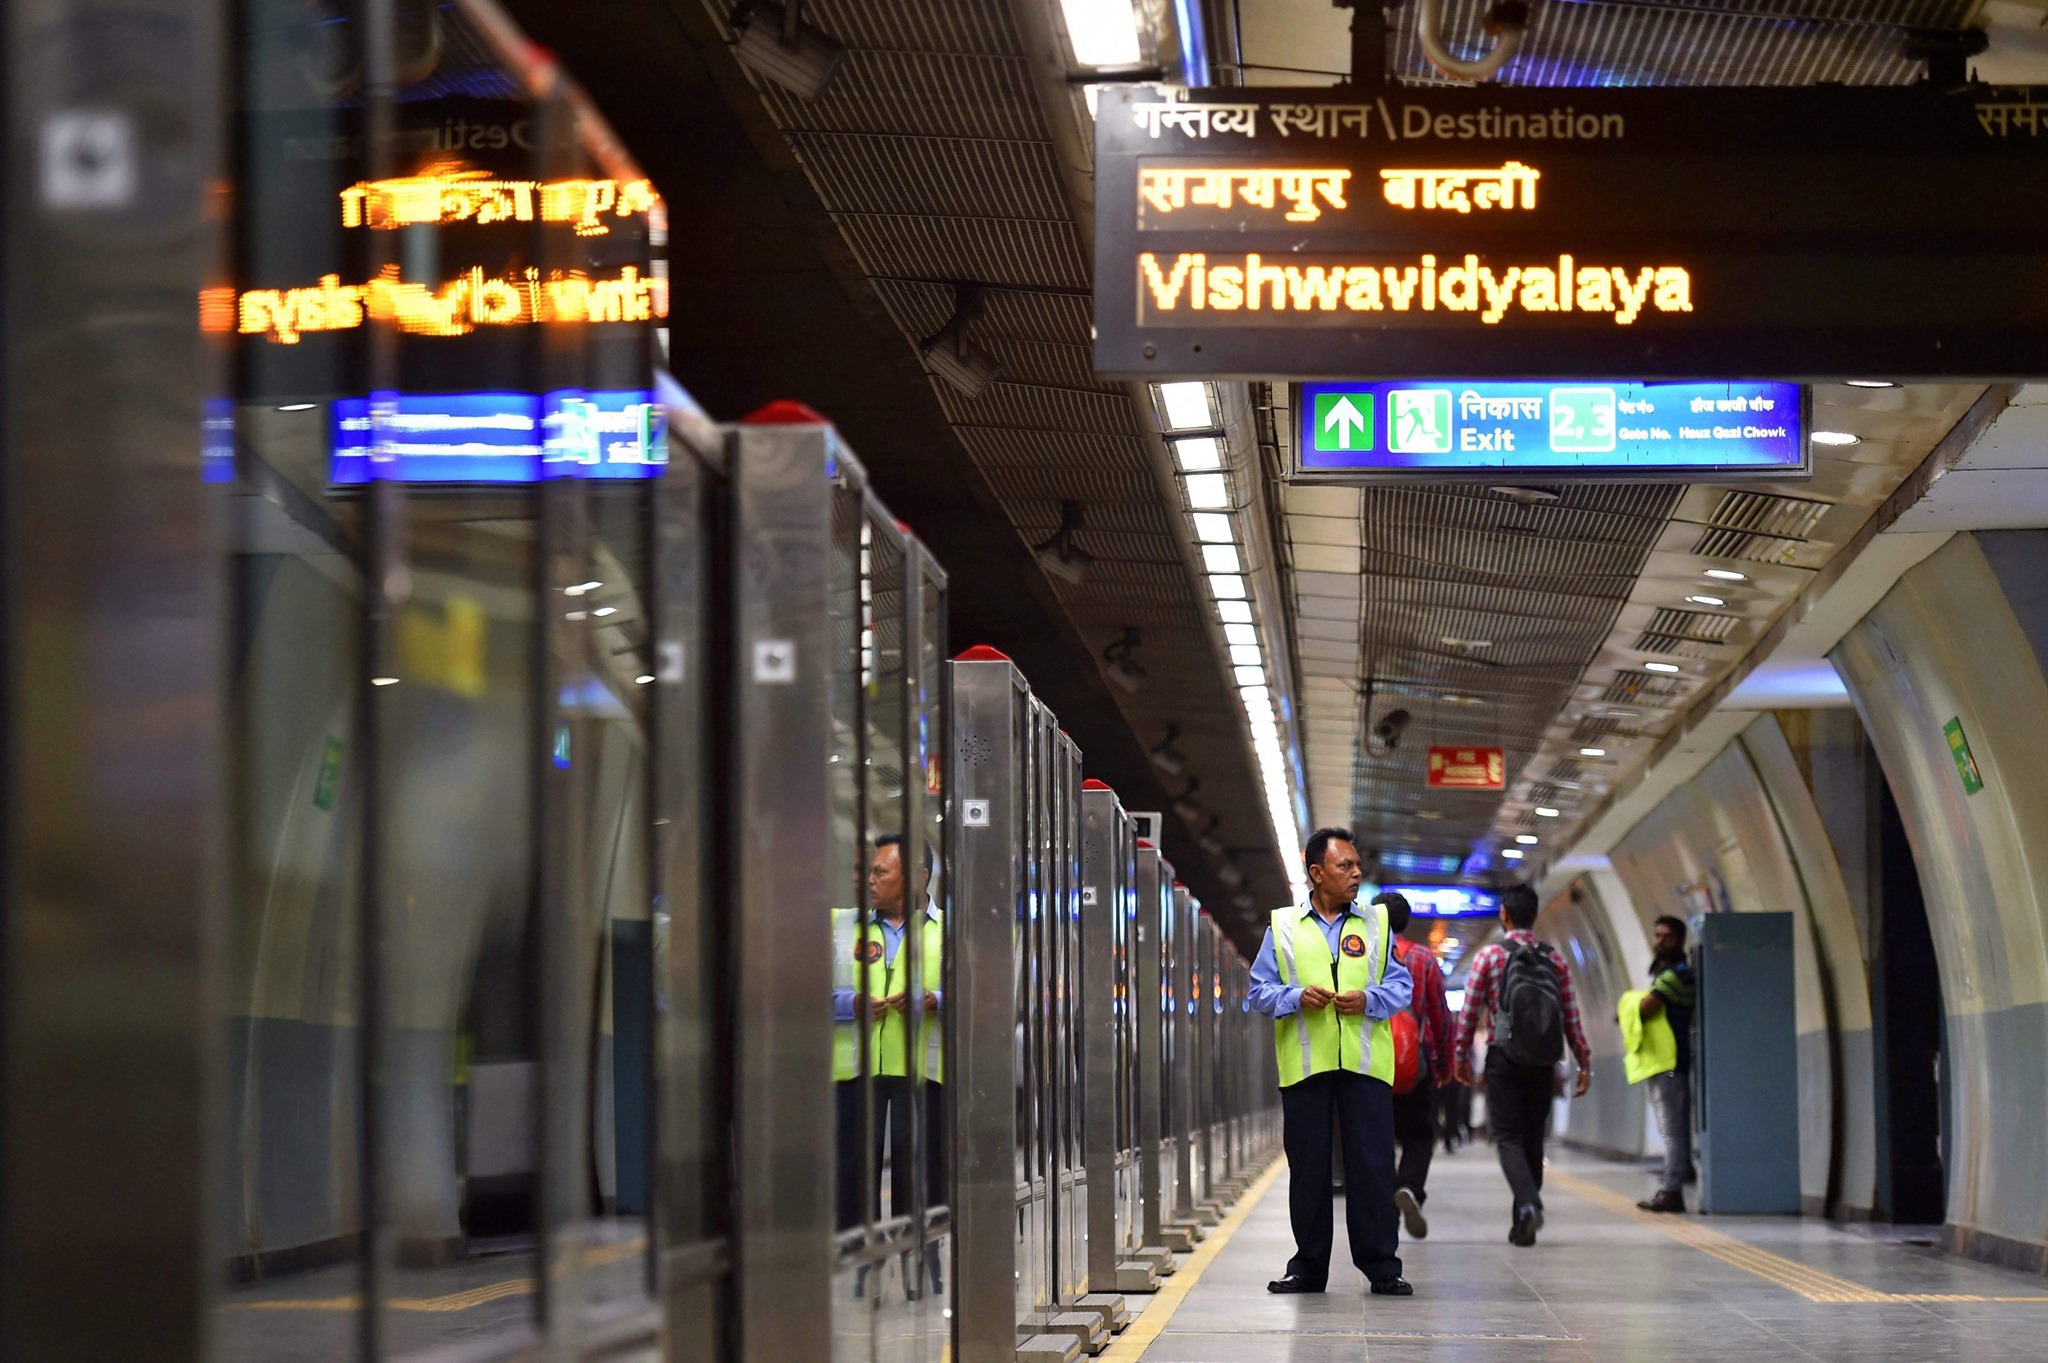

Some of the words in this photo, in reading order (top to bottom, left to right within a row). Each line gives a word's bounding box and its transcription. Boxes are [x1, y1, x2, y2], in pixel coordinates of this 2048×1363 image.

[1270, 104, 1372, 138] स्थान
[1402, 103, 1625, 140] Destination
[1974, 102, 2048, 137] सम
[1140, 253, 1693, 324] Vishwavidyalaya
[1459, 390, 1543, 420] निकास
[1460, 428, 1515, 451] Exit
[1743, 426, 1787, 439] Chowk
